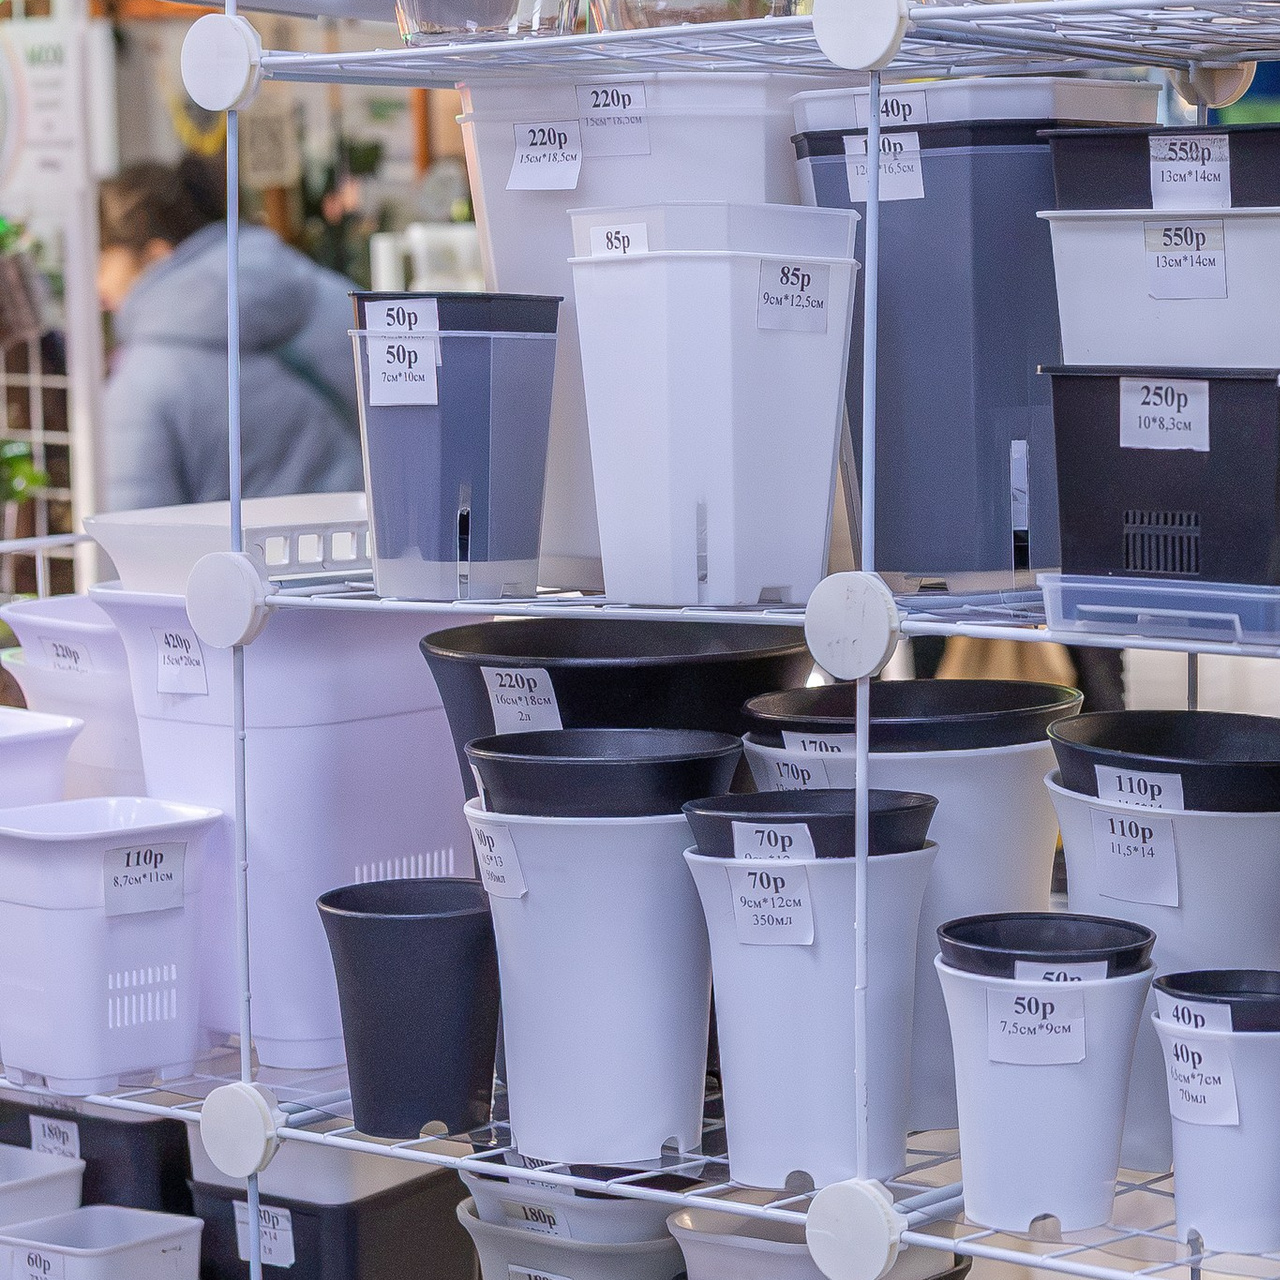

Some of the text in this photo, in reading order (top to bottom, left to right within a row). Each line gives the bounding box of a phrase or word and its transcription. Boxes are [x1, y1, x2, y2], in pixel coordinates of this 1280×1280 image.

[590, 88, 632, 109] 220р
[880, 99, 913, 121] 40р
[527, 127, 568, 149] 220р
[1167, 141, 1212, 166] 550р
[605, 230, 631, 254] 85р
[1161, 226, 1206, 252] 550р
[780, 266, 812, 292] 85р
[386, 307, 419, 330] 50р
[385, 344, 419, 368] 50р
[1139, 384, 1188, 412] 250р
[163, 632, 191, 655] 420р
[495, 672, 538, 693] 220р
[775, 761, 811, 786] 170р
[1115, 774, 1163, 802] 110р
[754, 829, 793, 852] 70р
[1107, 817, 1153, 843] 110р
[124, 848, 164, 869] 110р
[747, 871, 786, 894] 70р
[753, 913, 793, 927] 350мл
[1042, 971, 1082, 982] 50
[1013, 996, 1055, 1020] 50р
[1171, 1005, 1205, 1029] 40р
[1171, 1041, 1203, 1069] 40р
[1179, 1089, 1207, 1104] 70мл
[521, 1206, 556, 1230] 180р
[28, 1251, 52, 1274] 60р
